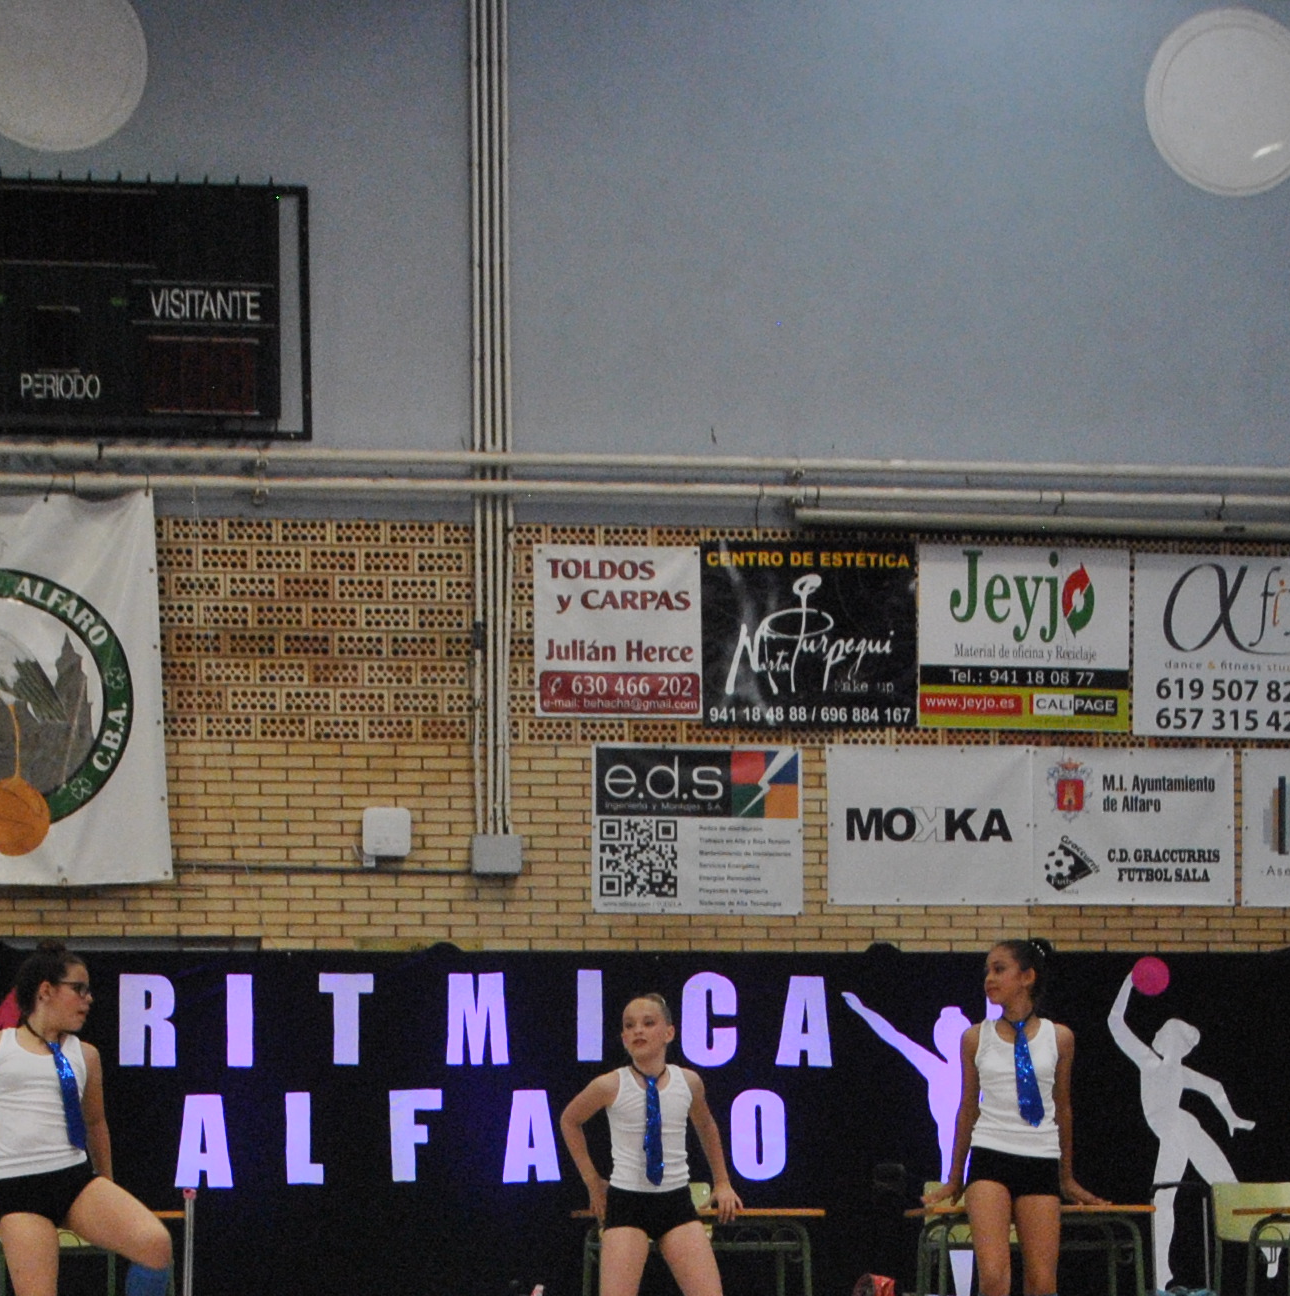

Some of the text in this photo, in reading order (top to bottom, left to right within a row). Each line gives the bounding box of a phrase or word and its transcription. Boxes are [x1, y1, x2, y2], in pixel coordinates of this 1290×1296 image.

[150, 290, 261, 321] VISITANTE
[20, 373, 101, 399] PERIODO
[546, 559, 656, 580] TOLDOS
[707, 551, 784, 567] CENTRO
[790, 552, 814, 567] DE
[556, 590, 691, 614] y CARPAS
[950, 550, 1095, 642] Jeyjo
[15, 577, 109, 647] ALFARO
[545, 639, 694, 662] Julián Herce
[954, 644, 1098, 662] Material de oficina y Reciclaje
[1164, 660, 1203, 671] dance
[1220, 660, 1262, 672] fitness
[571, 675, 693, 696] 630 466 202
[989, 670, 1019, 684] 941
[1026, 671, 1045, 684] 18
[1050, 671, 1070, 685] 08
[1075, 672, 1095, 686] 77
[1156, 677, 1205, 701] 619
[1211, 678, 1259, 702] 507
[925, 695, 1016, 711] www.jeyjo.es
[709, 706, 736, 723] 941
[743, 706, 761, 723] 18
[765, 706, 784, 723] 48
[789, 706, 807, 722] 88
[821, 707, 848, 723] 696
[852, 707, 879, 723] 884
[885, 707, 911, 723] 167
[1155, 707, 1204, 730] 657
[1211, 709, 1259, 732] 315
[604, 755, 724, 800] e.d.s
[1102, 774, 1216, 795] M.I. Ayuntamiento
[1102, 796, 1162, 813] de Alfaro
[1107, 848, 1221, 864] C.D. GRACCURRIS
[1117, 867, 1211, 883] FUTBOL SALA
[118, 968, 833, 1068] RITMICA
[175, 1088, 788, 1188] ALFAO
